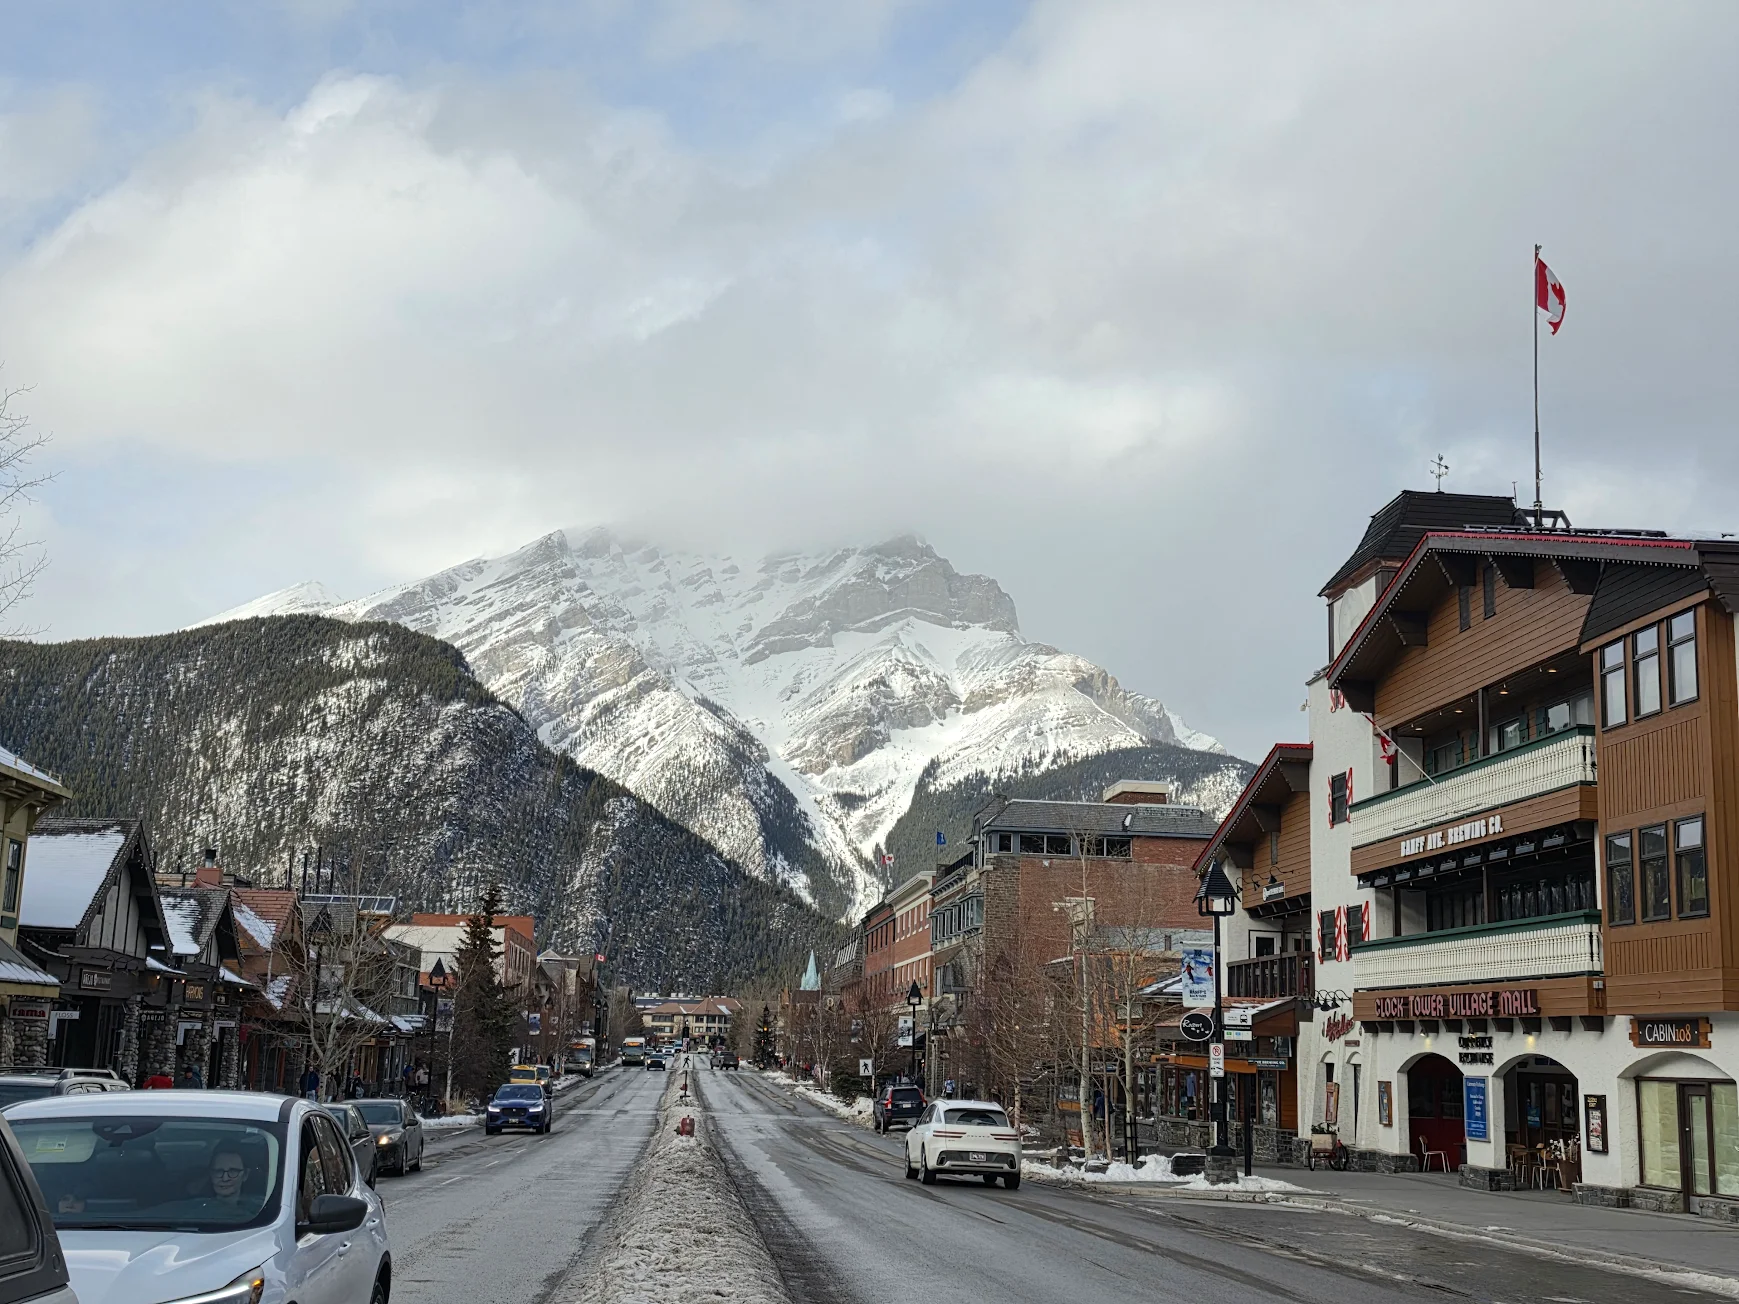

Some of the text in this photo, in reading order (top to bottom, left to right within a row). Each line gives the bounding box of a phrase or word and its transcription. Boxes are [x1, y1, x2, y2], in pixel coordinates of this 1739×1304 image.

[1400, 815, 1504, 857] BANFF AVE. BREWING CO.
[1374, 989, 1535, 1018] CLOCK TOWER VILLAGE MALL
